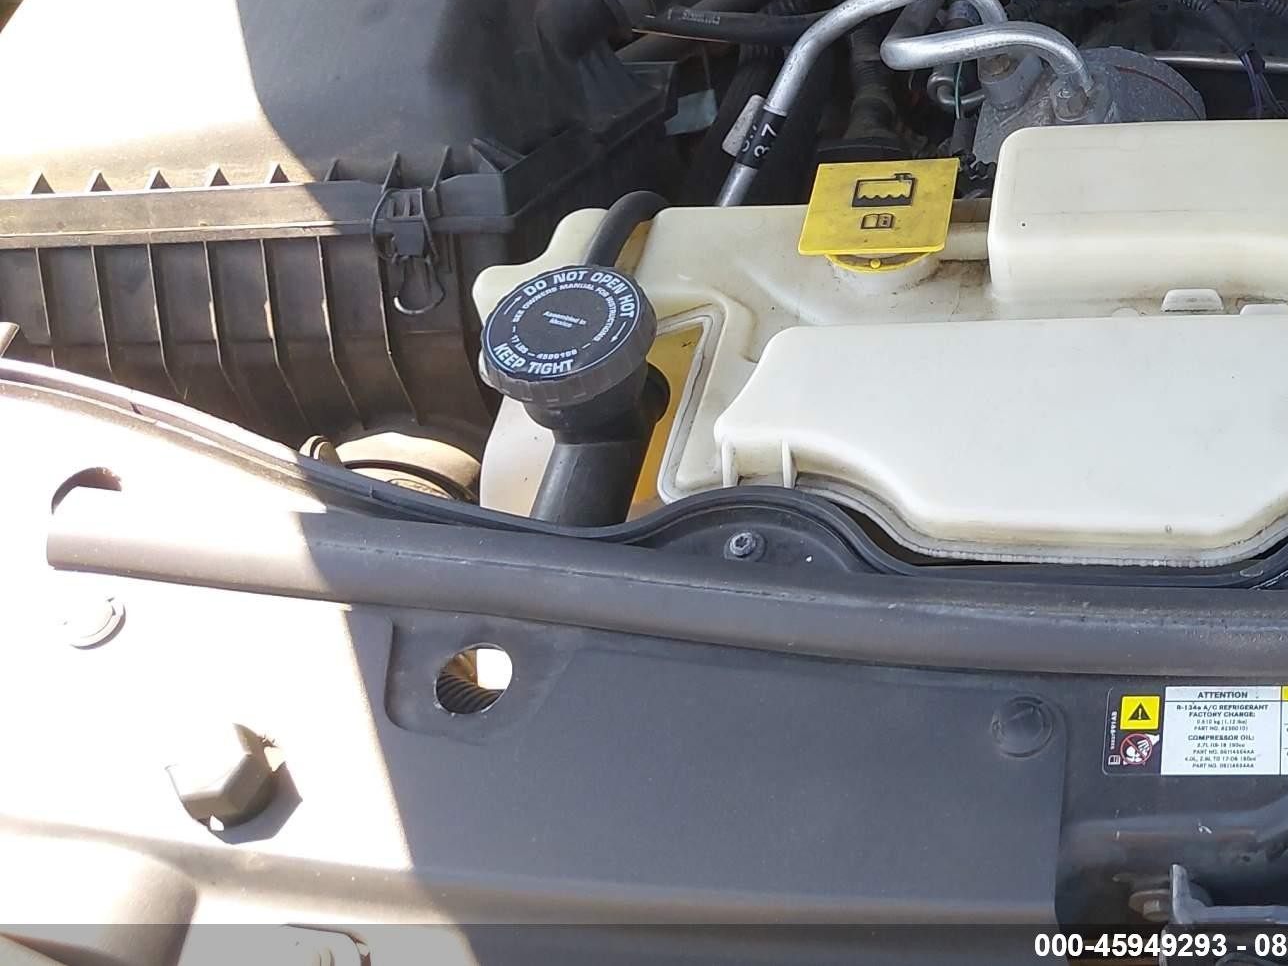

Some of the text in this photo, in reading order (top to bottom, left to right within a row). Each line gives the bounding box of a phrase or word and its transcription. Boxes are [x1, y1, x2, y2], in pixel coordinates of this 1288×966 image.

[523, 270, 637, 319] DO NOT OPEN HOT
[523, 287, 559, 310] OWNERS
[559, 282, 595, 292] MANUAL
[595, 286, 610, 298] FOR
[592, 296, 618, 342] INSTRUCTIONS
[494, 343, 575, 375] KEEP TIGHT
[1197, 691, 1248, 699] ATTENTION
